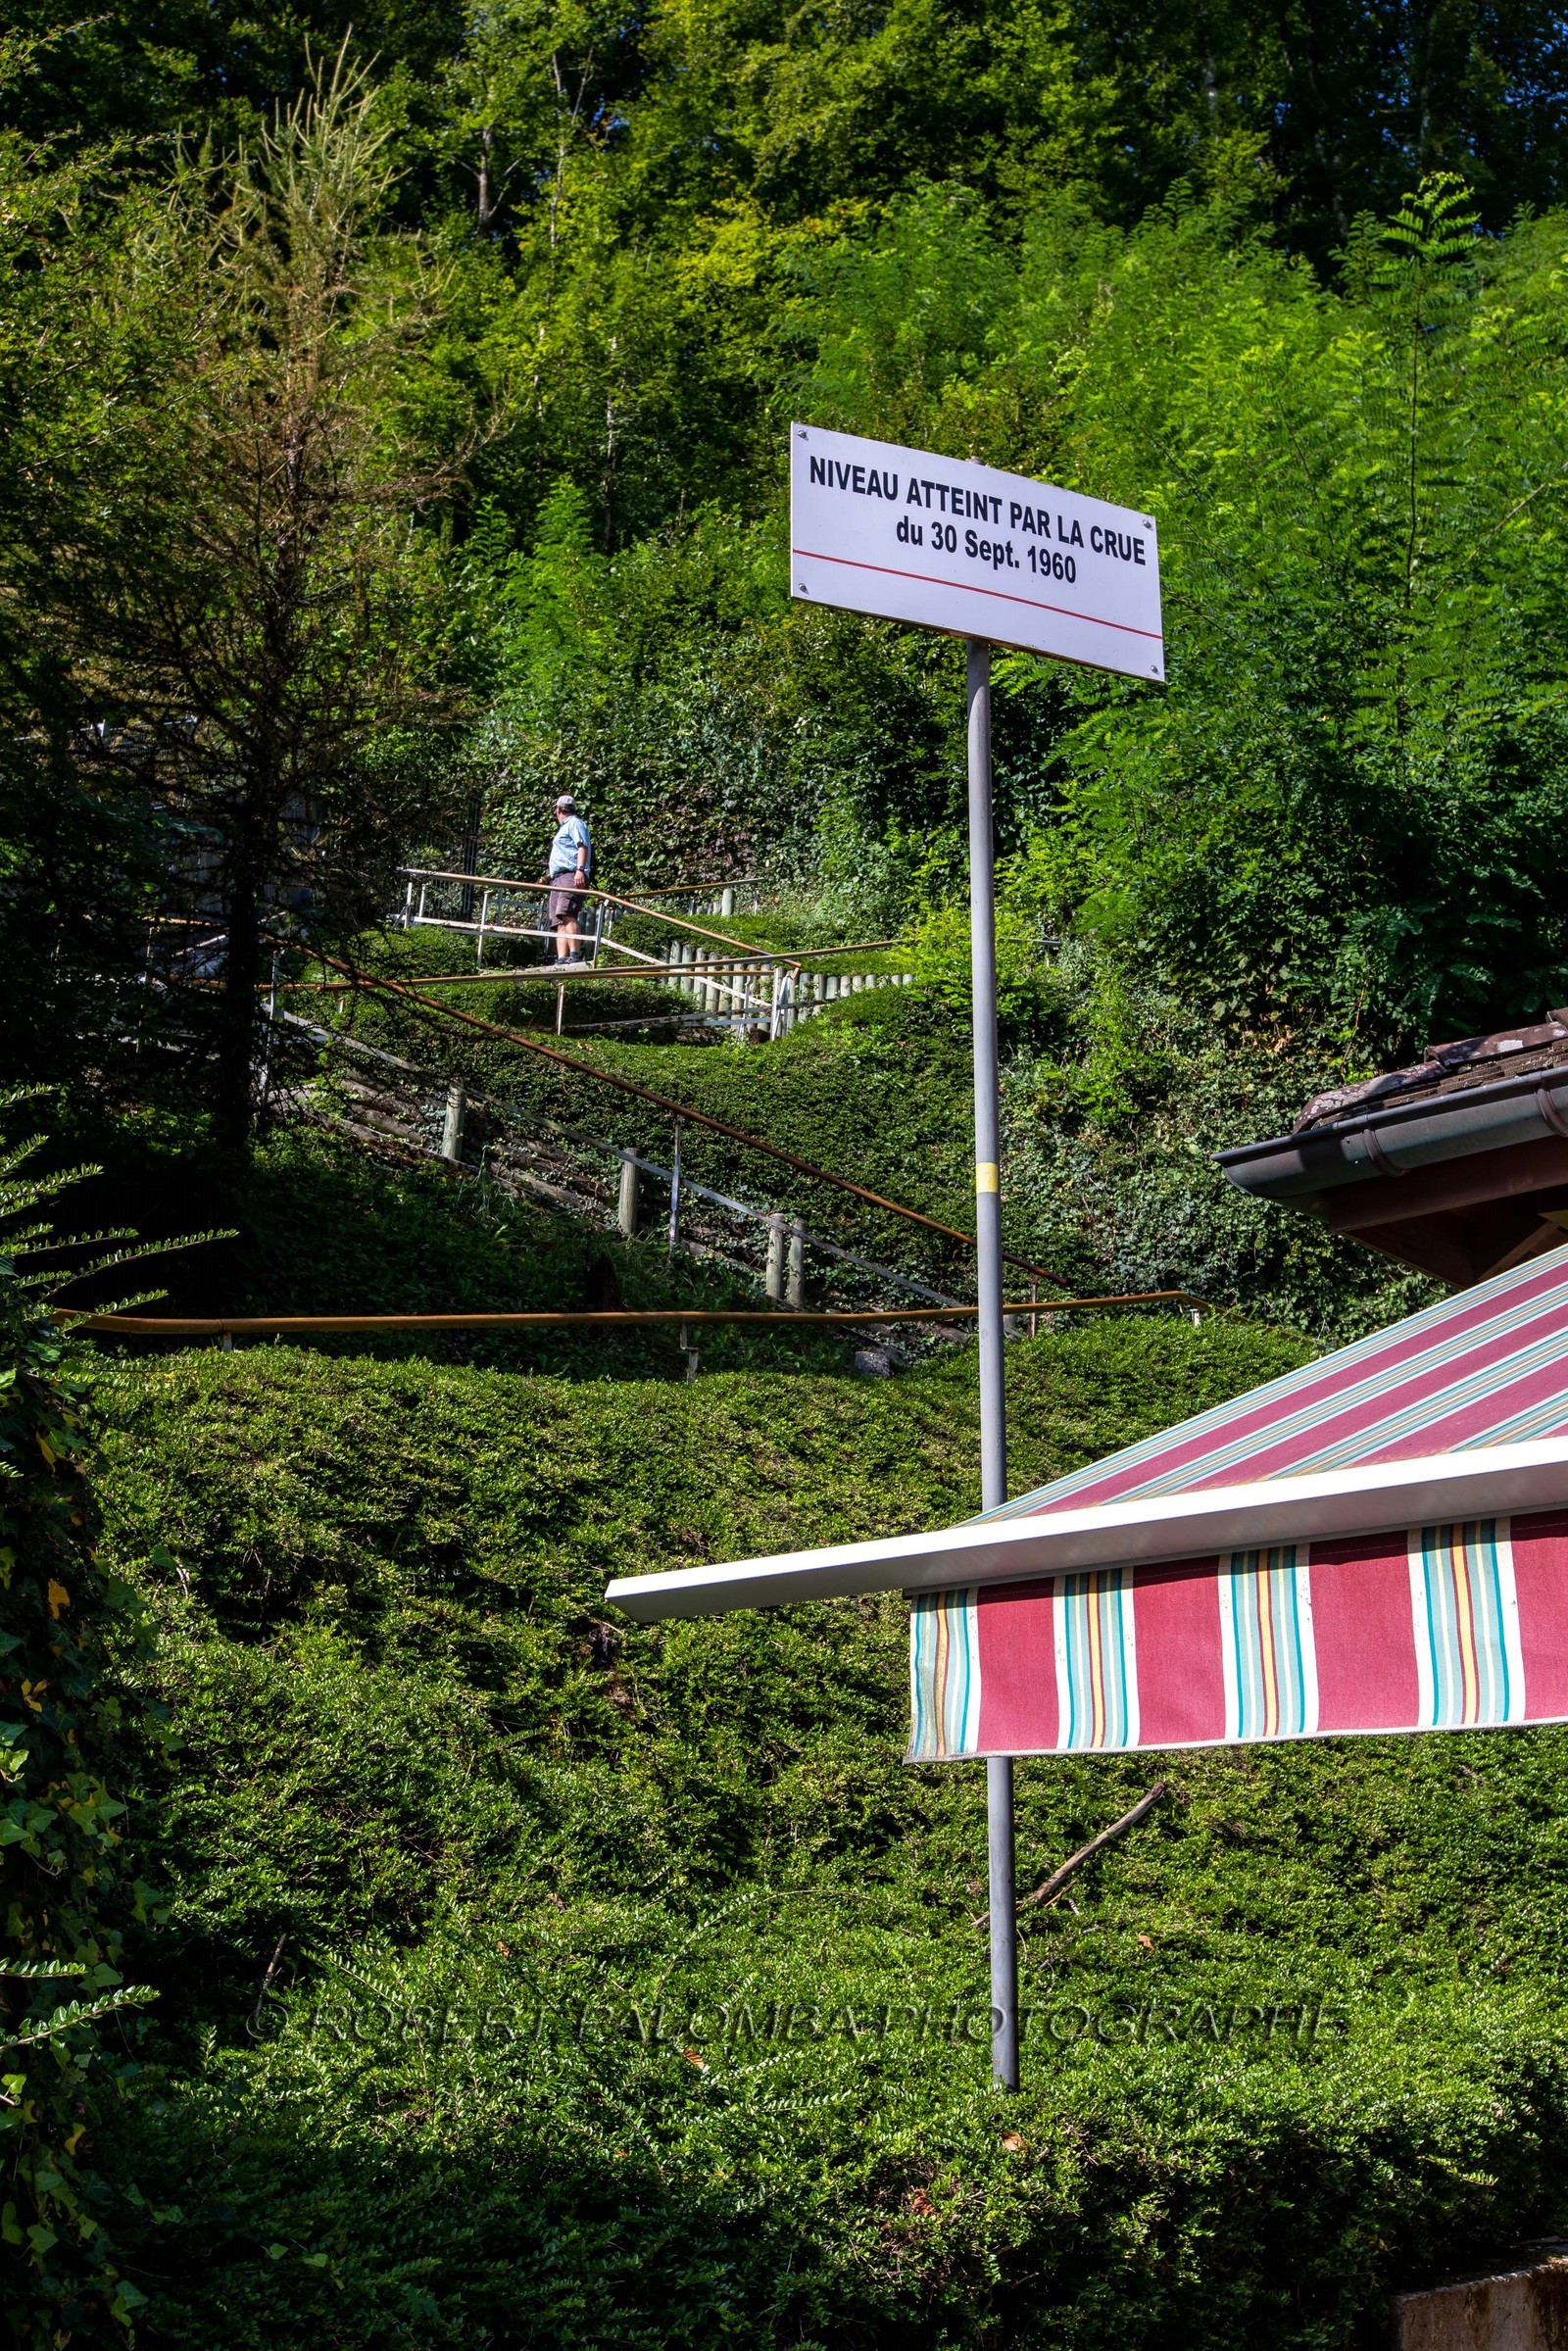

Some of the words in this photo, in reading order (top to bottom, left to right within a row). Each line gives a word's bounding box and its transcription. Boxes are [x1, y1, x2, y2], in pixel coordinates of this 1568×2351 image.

[809, 455, 899, 501] NIVEAU
[906, 477, 1003, 525] ATTEINT
[1009, 501, 1052, 539] PAR
[1057, 514, 1085, 549] LA
[1090, 525, 1147, 566] CRUE
[896, 514, 923, 547] du
[931, 521, 957, 554] 30
[964, 529, 1020, 571] Sept.
[1027, 545, 1077, 584] 1960
